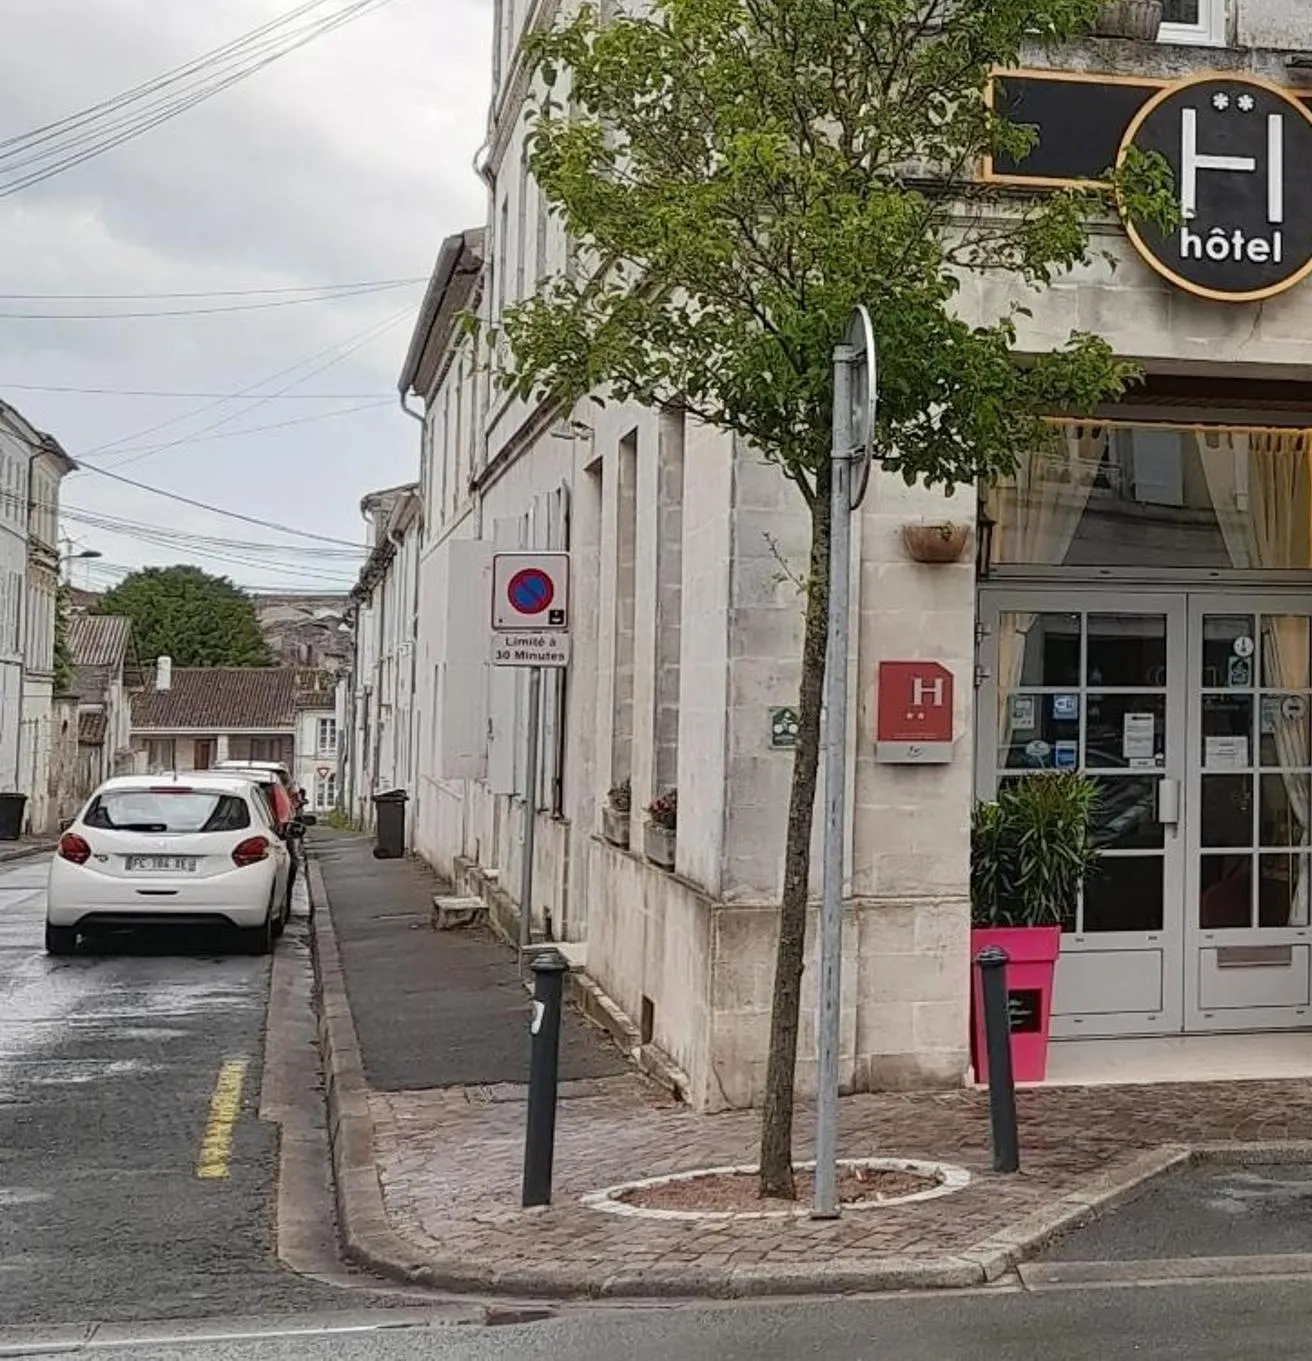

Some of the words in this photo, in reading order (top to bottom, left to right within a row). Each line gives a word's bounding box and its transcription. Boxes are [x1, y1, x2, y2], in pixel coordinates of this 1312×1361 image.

[1180, 227, 1282, 263] hôtel
[505, 636, 545, 647] Limité
[549, 637, 557, 647] à
[515, 650, 565, 661] Minutes
[913, 678, 943, 707] H
